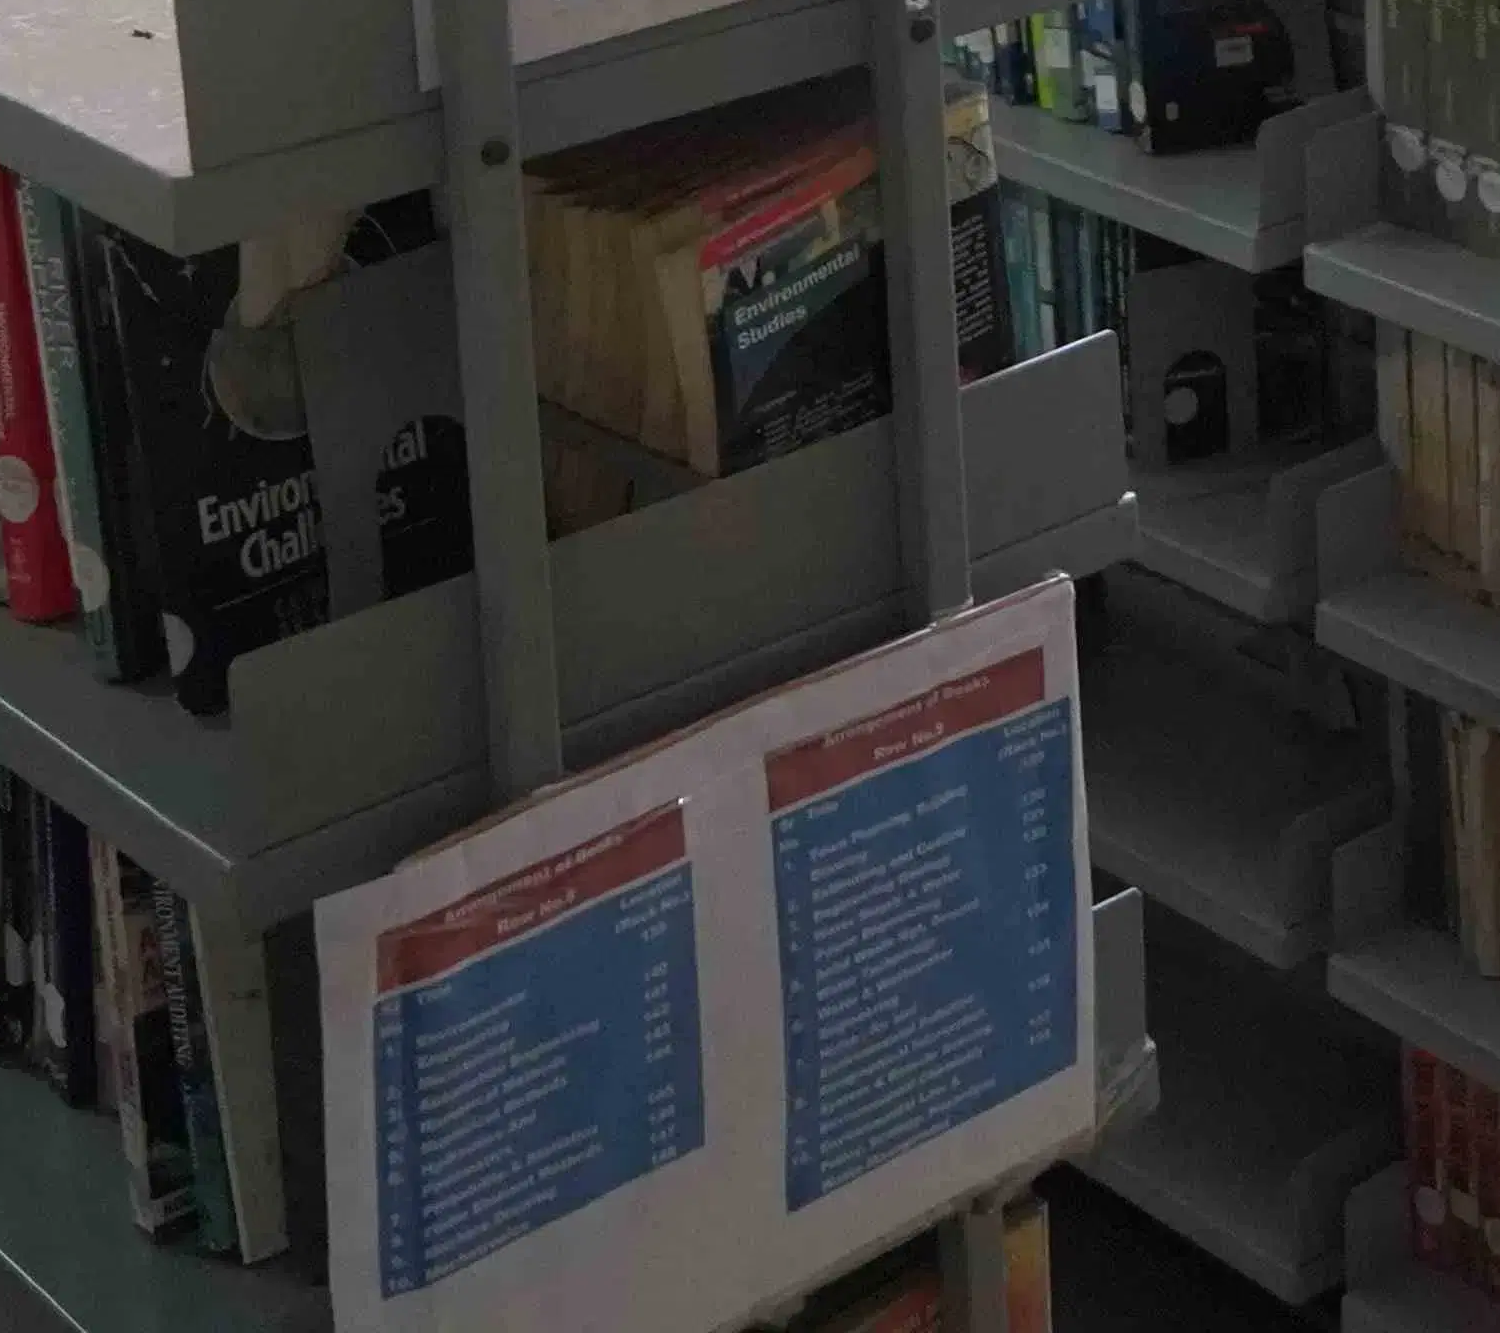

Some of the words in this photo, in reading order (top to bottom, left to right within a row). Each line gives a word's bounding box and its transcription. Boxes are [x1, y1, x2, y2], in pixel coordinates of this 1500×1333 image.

[45, 255, 77, 372] RIVER
[733, 241, 861, 327] Environmental
[737, 306, 808, 351] Studies
